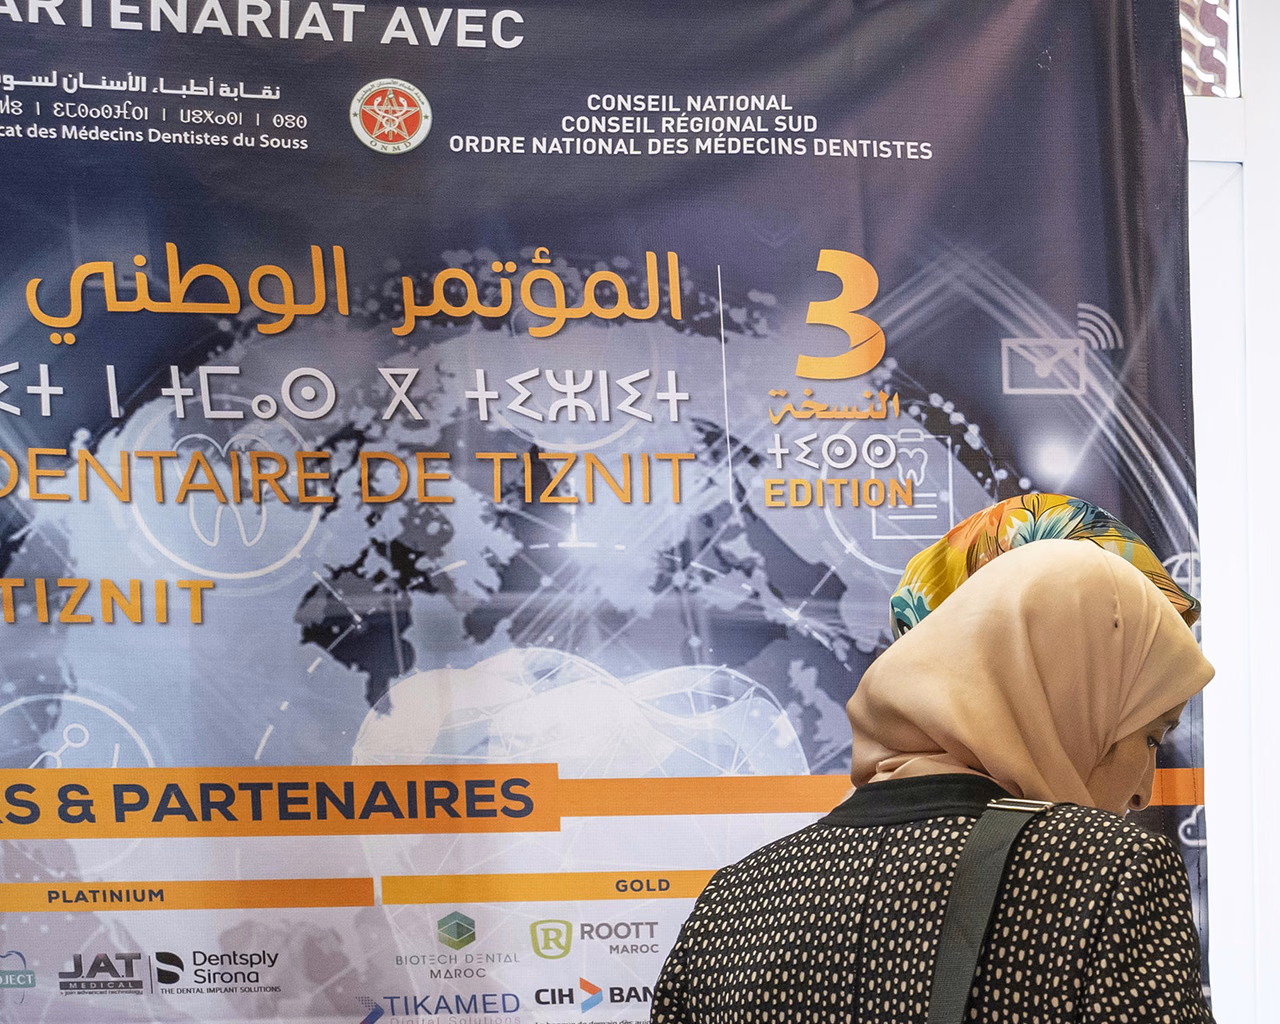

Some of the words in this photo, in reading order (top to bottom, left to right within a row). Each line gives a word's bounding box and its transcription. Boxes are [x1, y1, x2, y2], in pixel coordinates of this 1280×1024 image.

[380, 8, 524, 49] AVEC
[587, 94, 680, 113] CONSEIL
[687, 94, 792, 113] NATIONAL
[561, 115, 654, 134] CONSEIL
[661, 112, 768, 134] RÉGIONAL
[774, 115, 817, 133] SUD
[27, 124, 57, 139] des
[62, 125, 144, 142] Médecins
[148, 128, 229, 147] Dentistes
[233, 132, 254, 147] du
[259, 134, 309, 150] Souss
[449, 135, 525, 154] ORDRE
[531, 136, 641, 155] NATIONAL
[648, 137, 689, 155] DES
[695, 133, 807, 156] MÉDECINS
[813, 138, 933, 161] DENTISTES
[26, 241, 349, 345] الوطني
[391, 247, 683, 337] المؤتمر
[795, 249, 886, 380] 3
[768, 389, 900, 425] النسخة
[361, 452, 454, 504] DE
[475, 453, 697, 504] TIZNIT
[764, 478, 915, 508] EDITION
[56, 784, 97, 825] &
[113, 778, 535, 825] PARTENAIRES
[47, 887, 164, 905] PLATINIUM
[615, 878, 671, 894] GOLD
[580, 922, 659, 940] ROOTT
[193, 950, 279, 969] Dentsply
[396, 954, 458, 966] BIOTECH
[465, 953, 521, 964] DENTAL
[609, 944, 660, 955] MAROC
[193, 970, 260, 984] Sirona
[430, 968, 487, 979] MAROC
[176, 987, 205, 995] DENTAL
[206, 986, 238, 994] IMPLANT
[534, 988, 575, 1005] CIH
[383, 993, 520, 1017] TIKAMED
